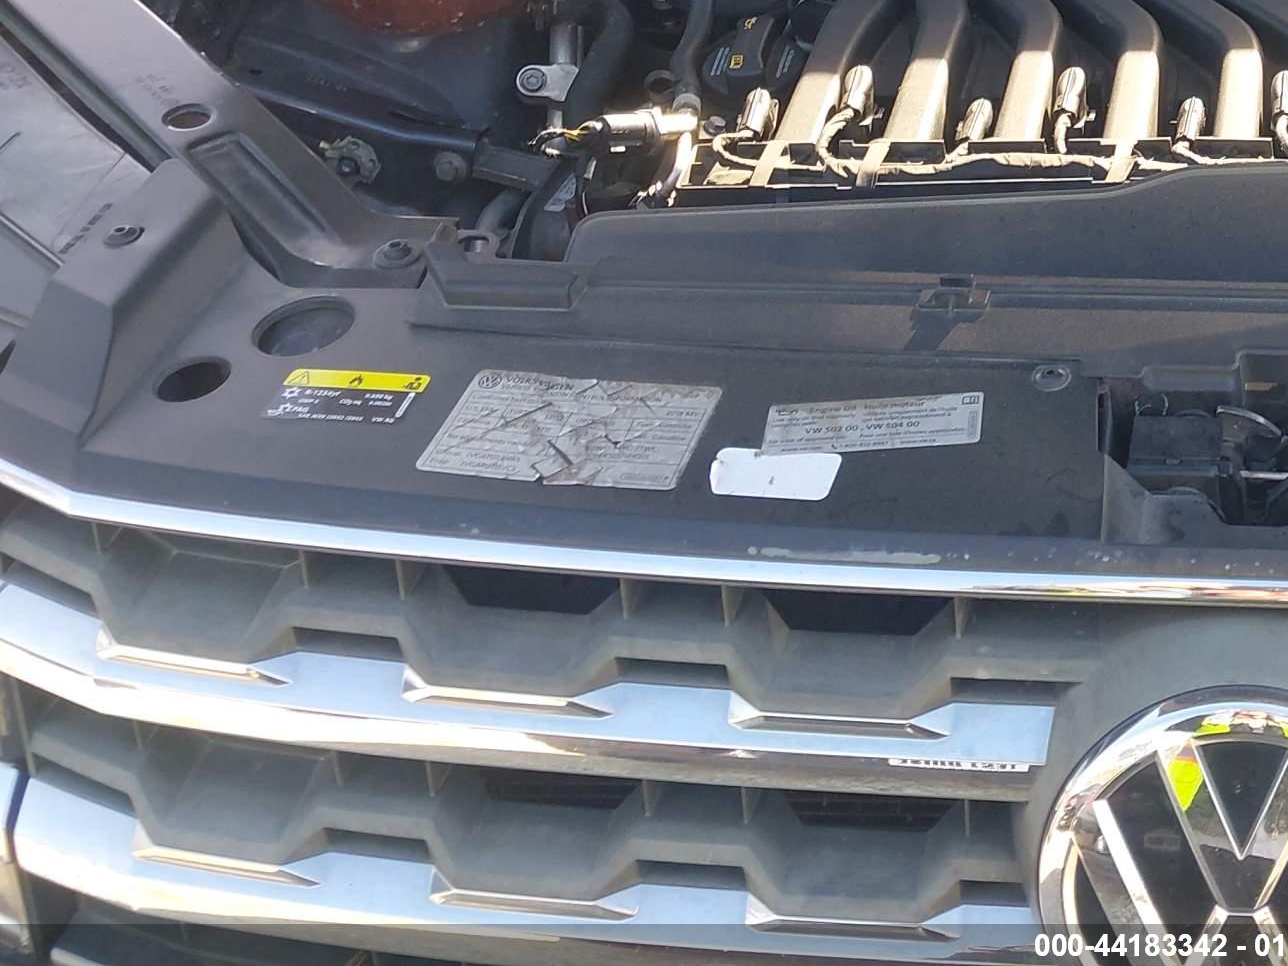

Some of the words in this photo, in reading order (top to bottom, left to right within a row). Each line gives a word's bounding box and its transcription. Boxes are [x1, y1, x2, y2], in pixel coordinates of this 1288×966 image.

[804, 427, 823, 435] VW
[825, 425, 843, 434] 502
[865, 422, 884, 431] VW
[906, 420, 920, 428] 00
